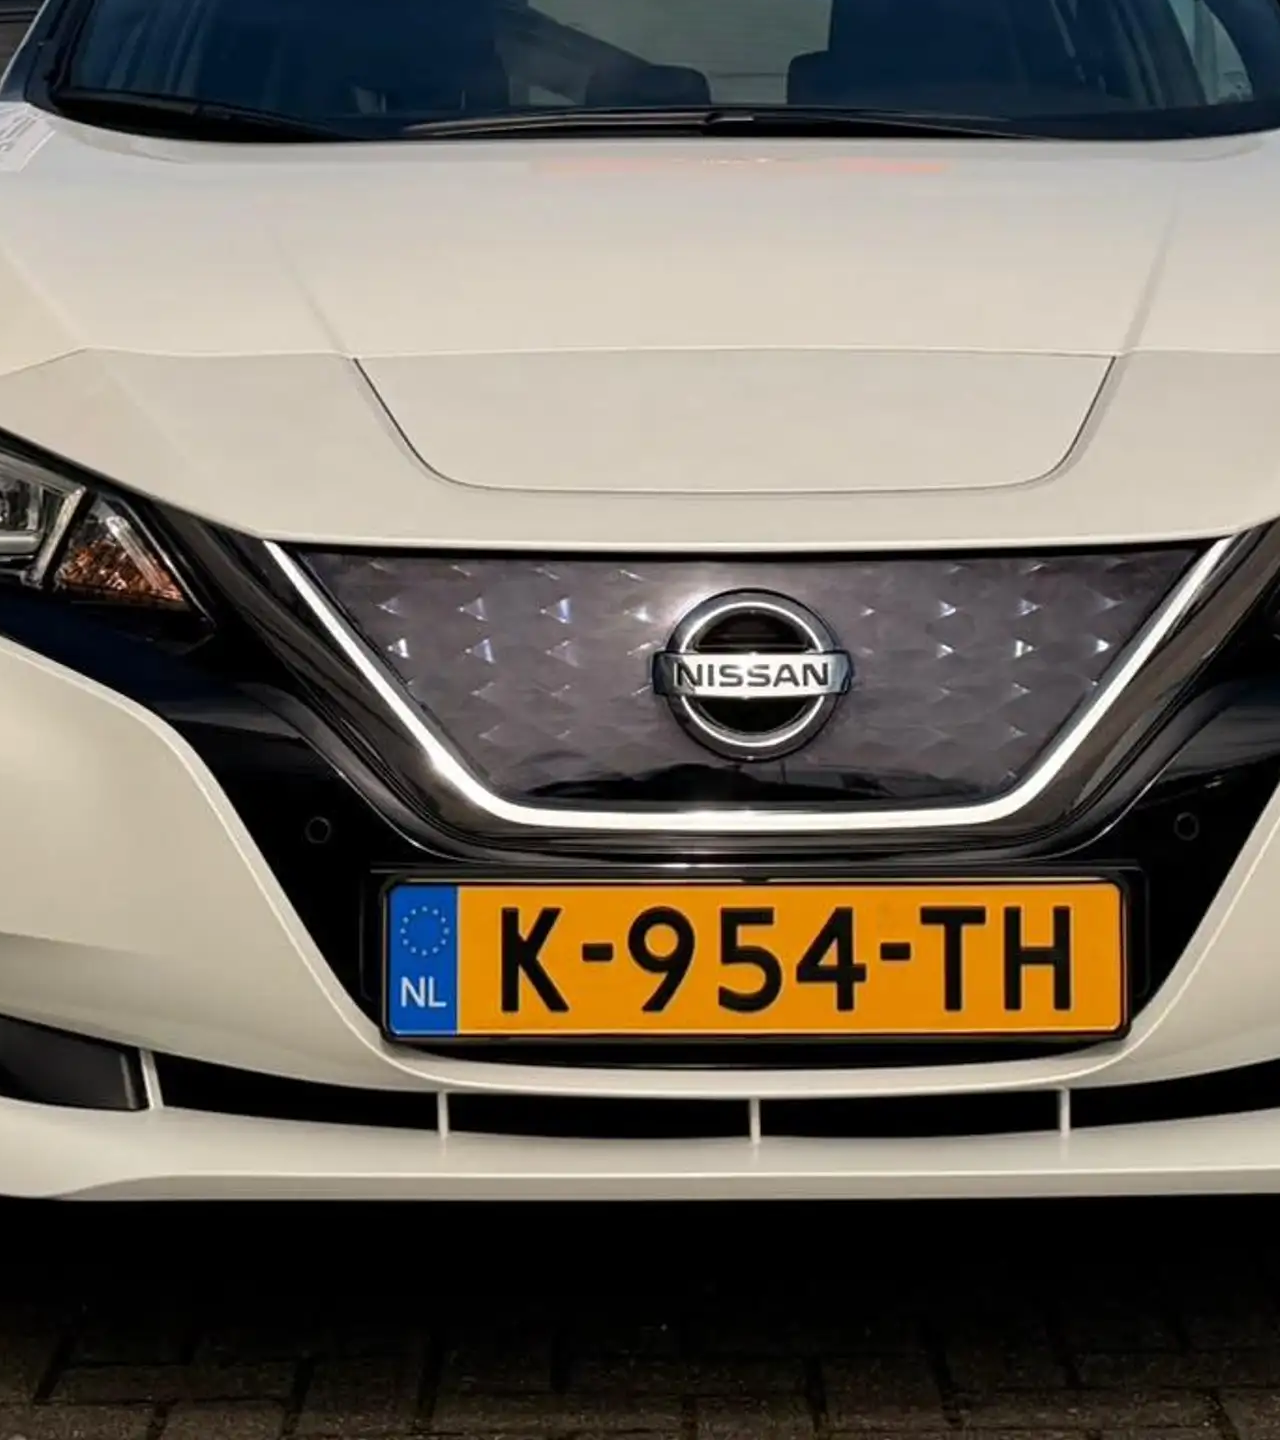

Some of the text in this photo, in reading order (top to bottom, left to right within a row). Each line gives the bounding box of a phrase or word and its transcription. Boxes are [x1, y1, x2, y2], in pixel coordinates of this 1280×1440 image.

[675, 662, 829, 688] NISSAN
[500, 905, 1073, 1014] K-954-TH
[400, 976, 447, 1008] NL
